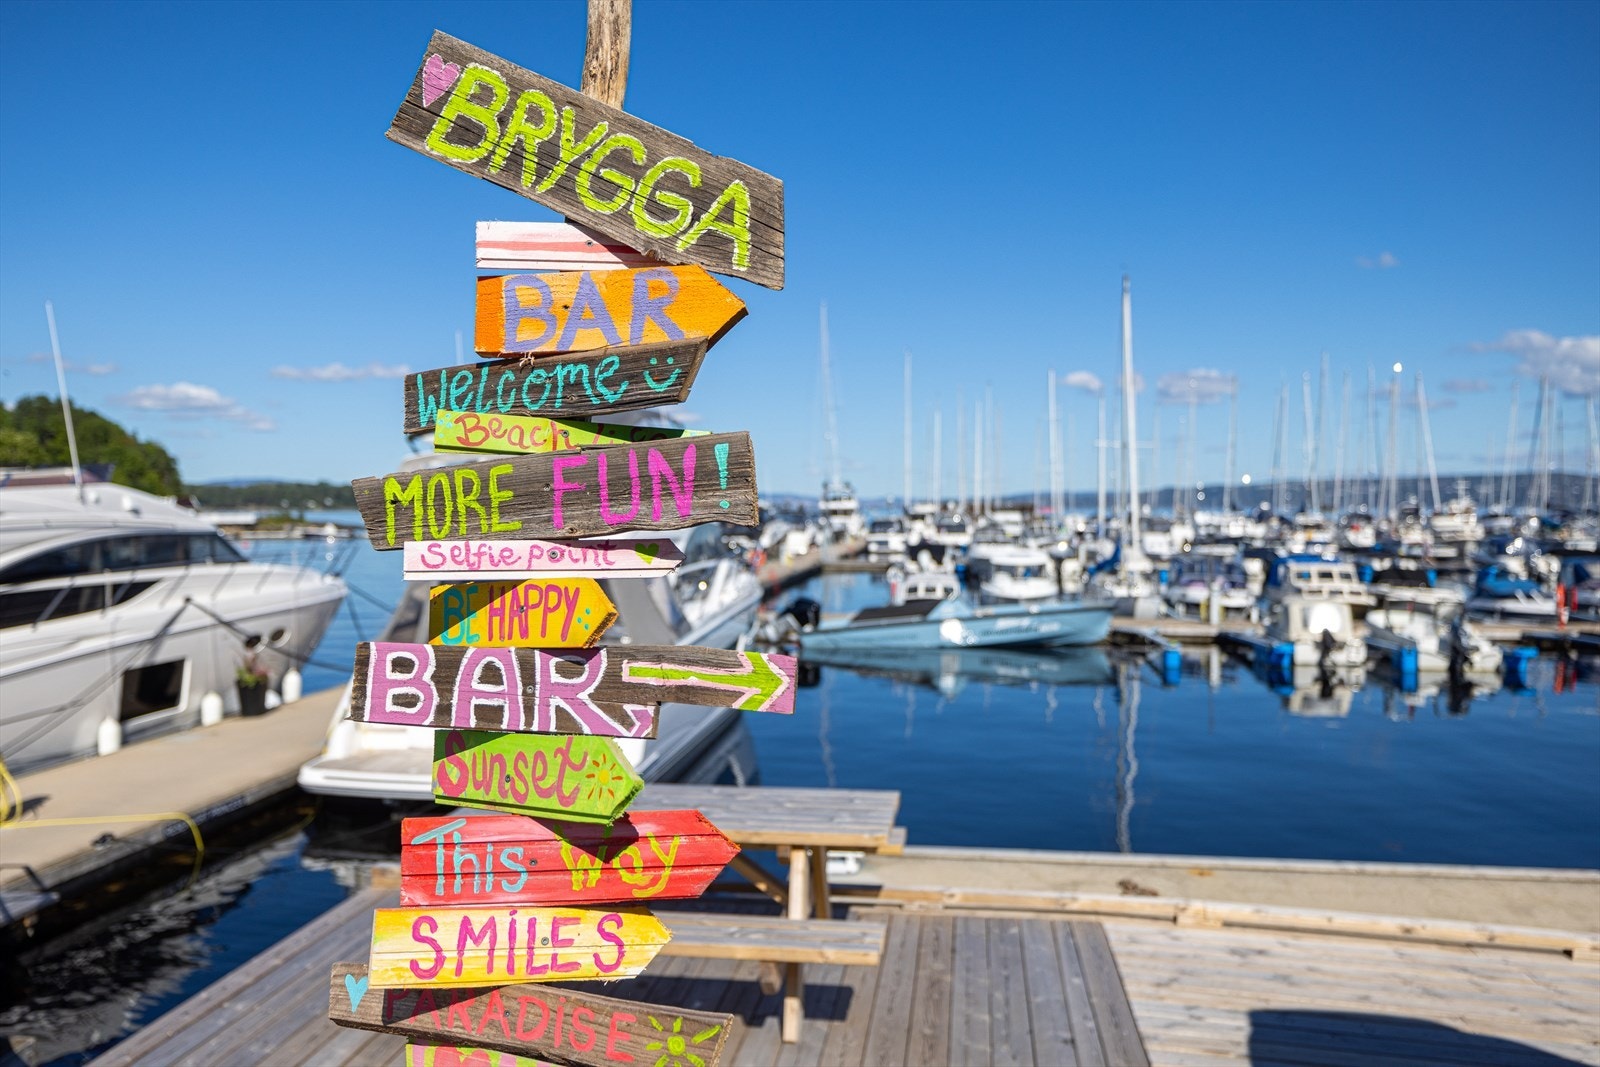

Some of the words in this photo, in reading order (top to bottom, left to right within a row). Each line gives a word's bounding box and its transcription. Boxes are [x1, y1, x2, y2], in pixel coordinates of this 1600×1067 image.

[425, 62, 752, 272] BRYGGA
[502, 267, 686, 353] BAR
[416, 355, 629, 427] Welcome
[453, 412, 581, 451] Beach
[383, 463, 523, 547] MORE
[420, 540, 522, 571] Selfie
[527, 540, 617, 570] point
[440, 585, 481, 646] BE
[487, 584, 581, 642] HAPPY
[363, 641, 648, 738] BAR
[436, 732, 590, 808] Sunset
[411, 818, 529, 897] This
[554, 822, 681, 898] Way
